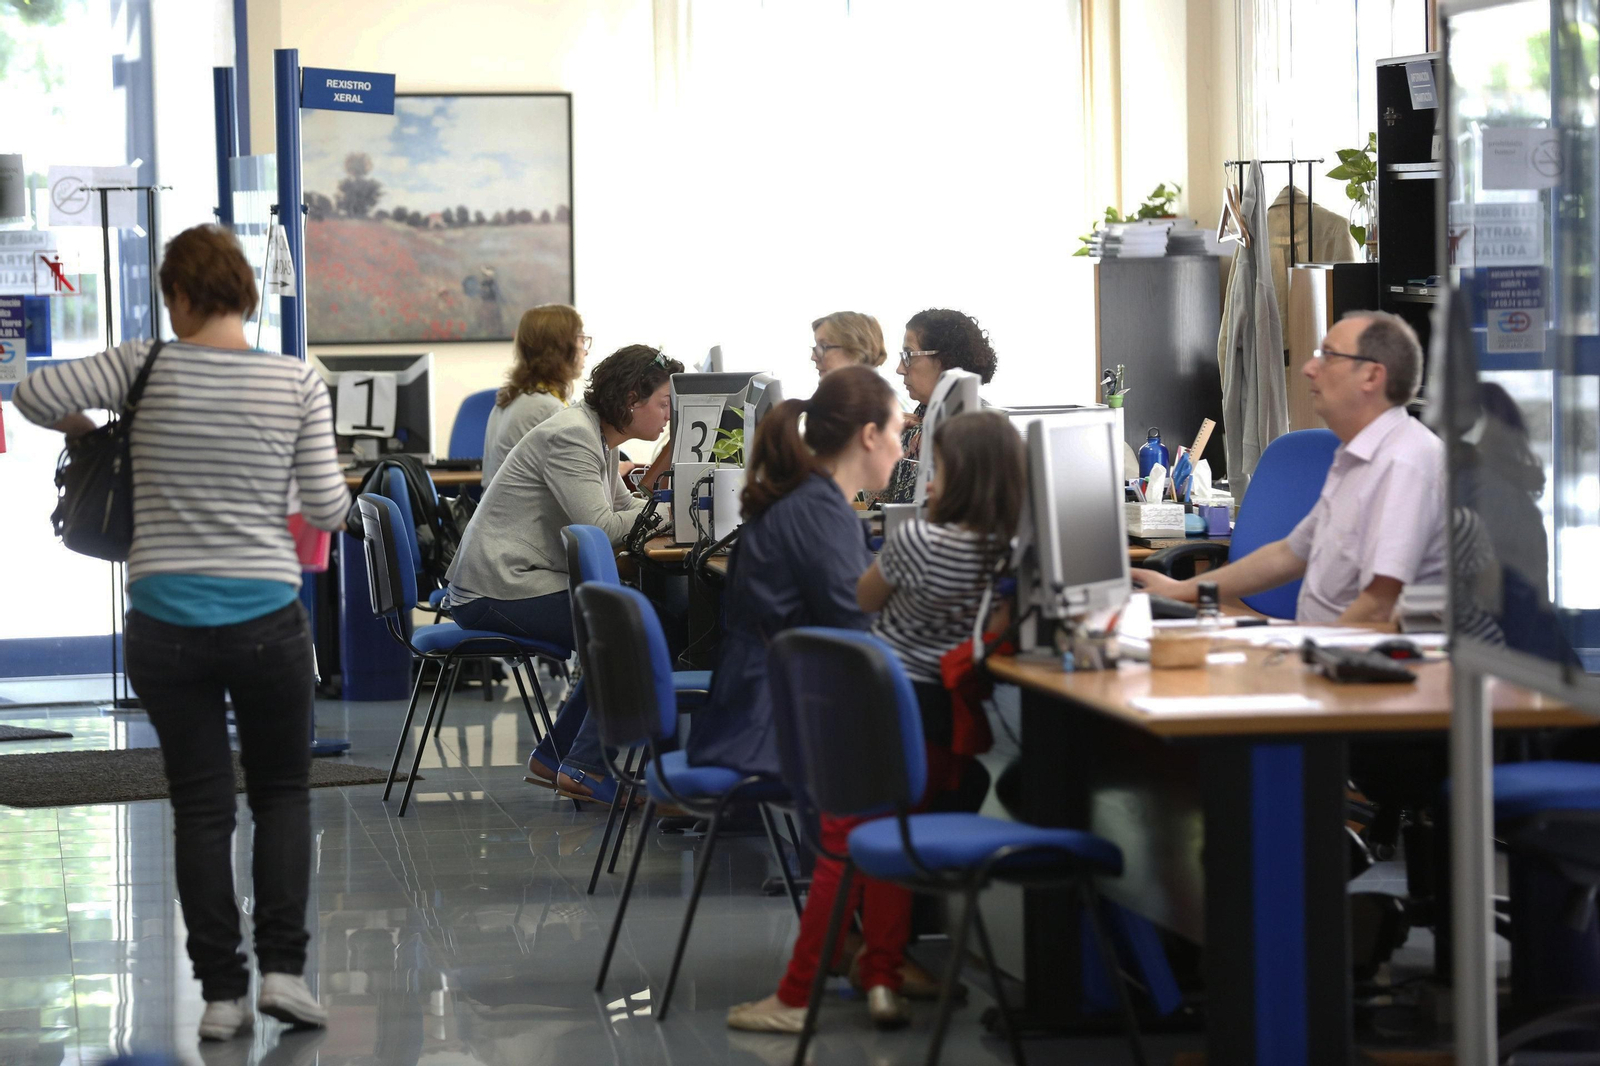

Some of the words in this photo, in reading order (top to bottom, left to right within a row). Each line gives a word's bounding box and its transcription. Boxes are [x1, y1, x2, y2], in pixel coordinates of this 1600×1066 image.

[326, 79, 372, 90] REXISTRO
[333, 93, 363, 104] XERAL
[352, 377, 385, 431] 1
[691, 421, 708, 462] 3
